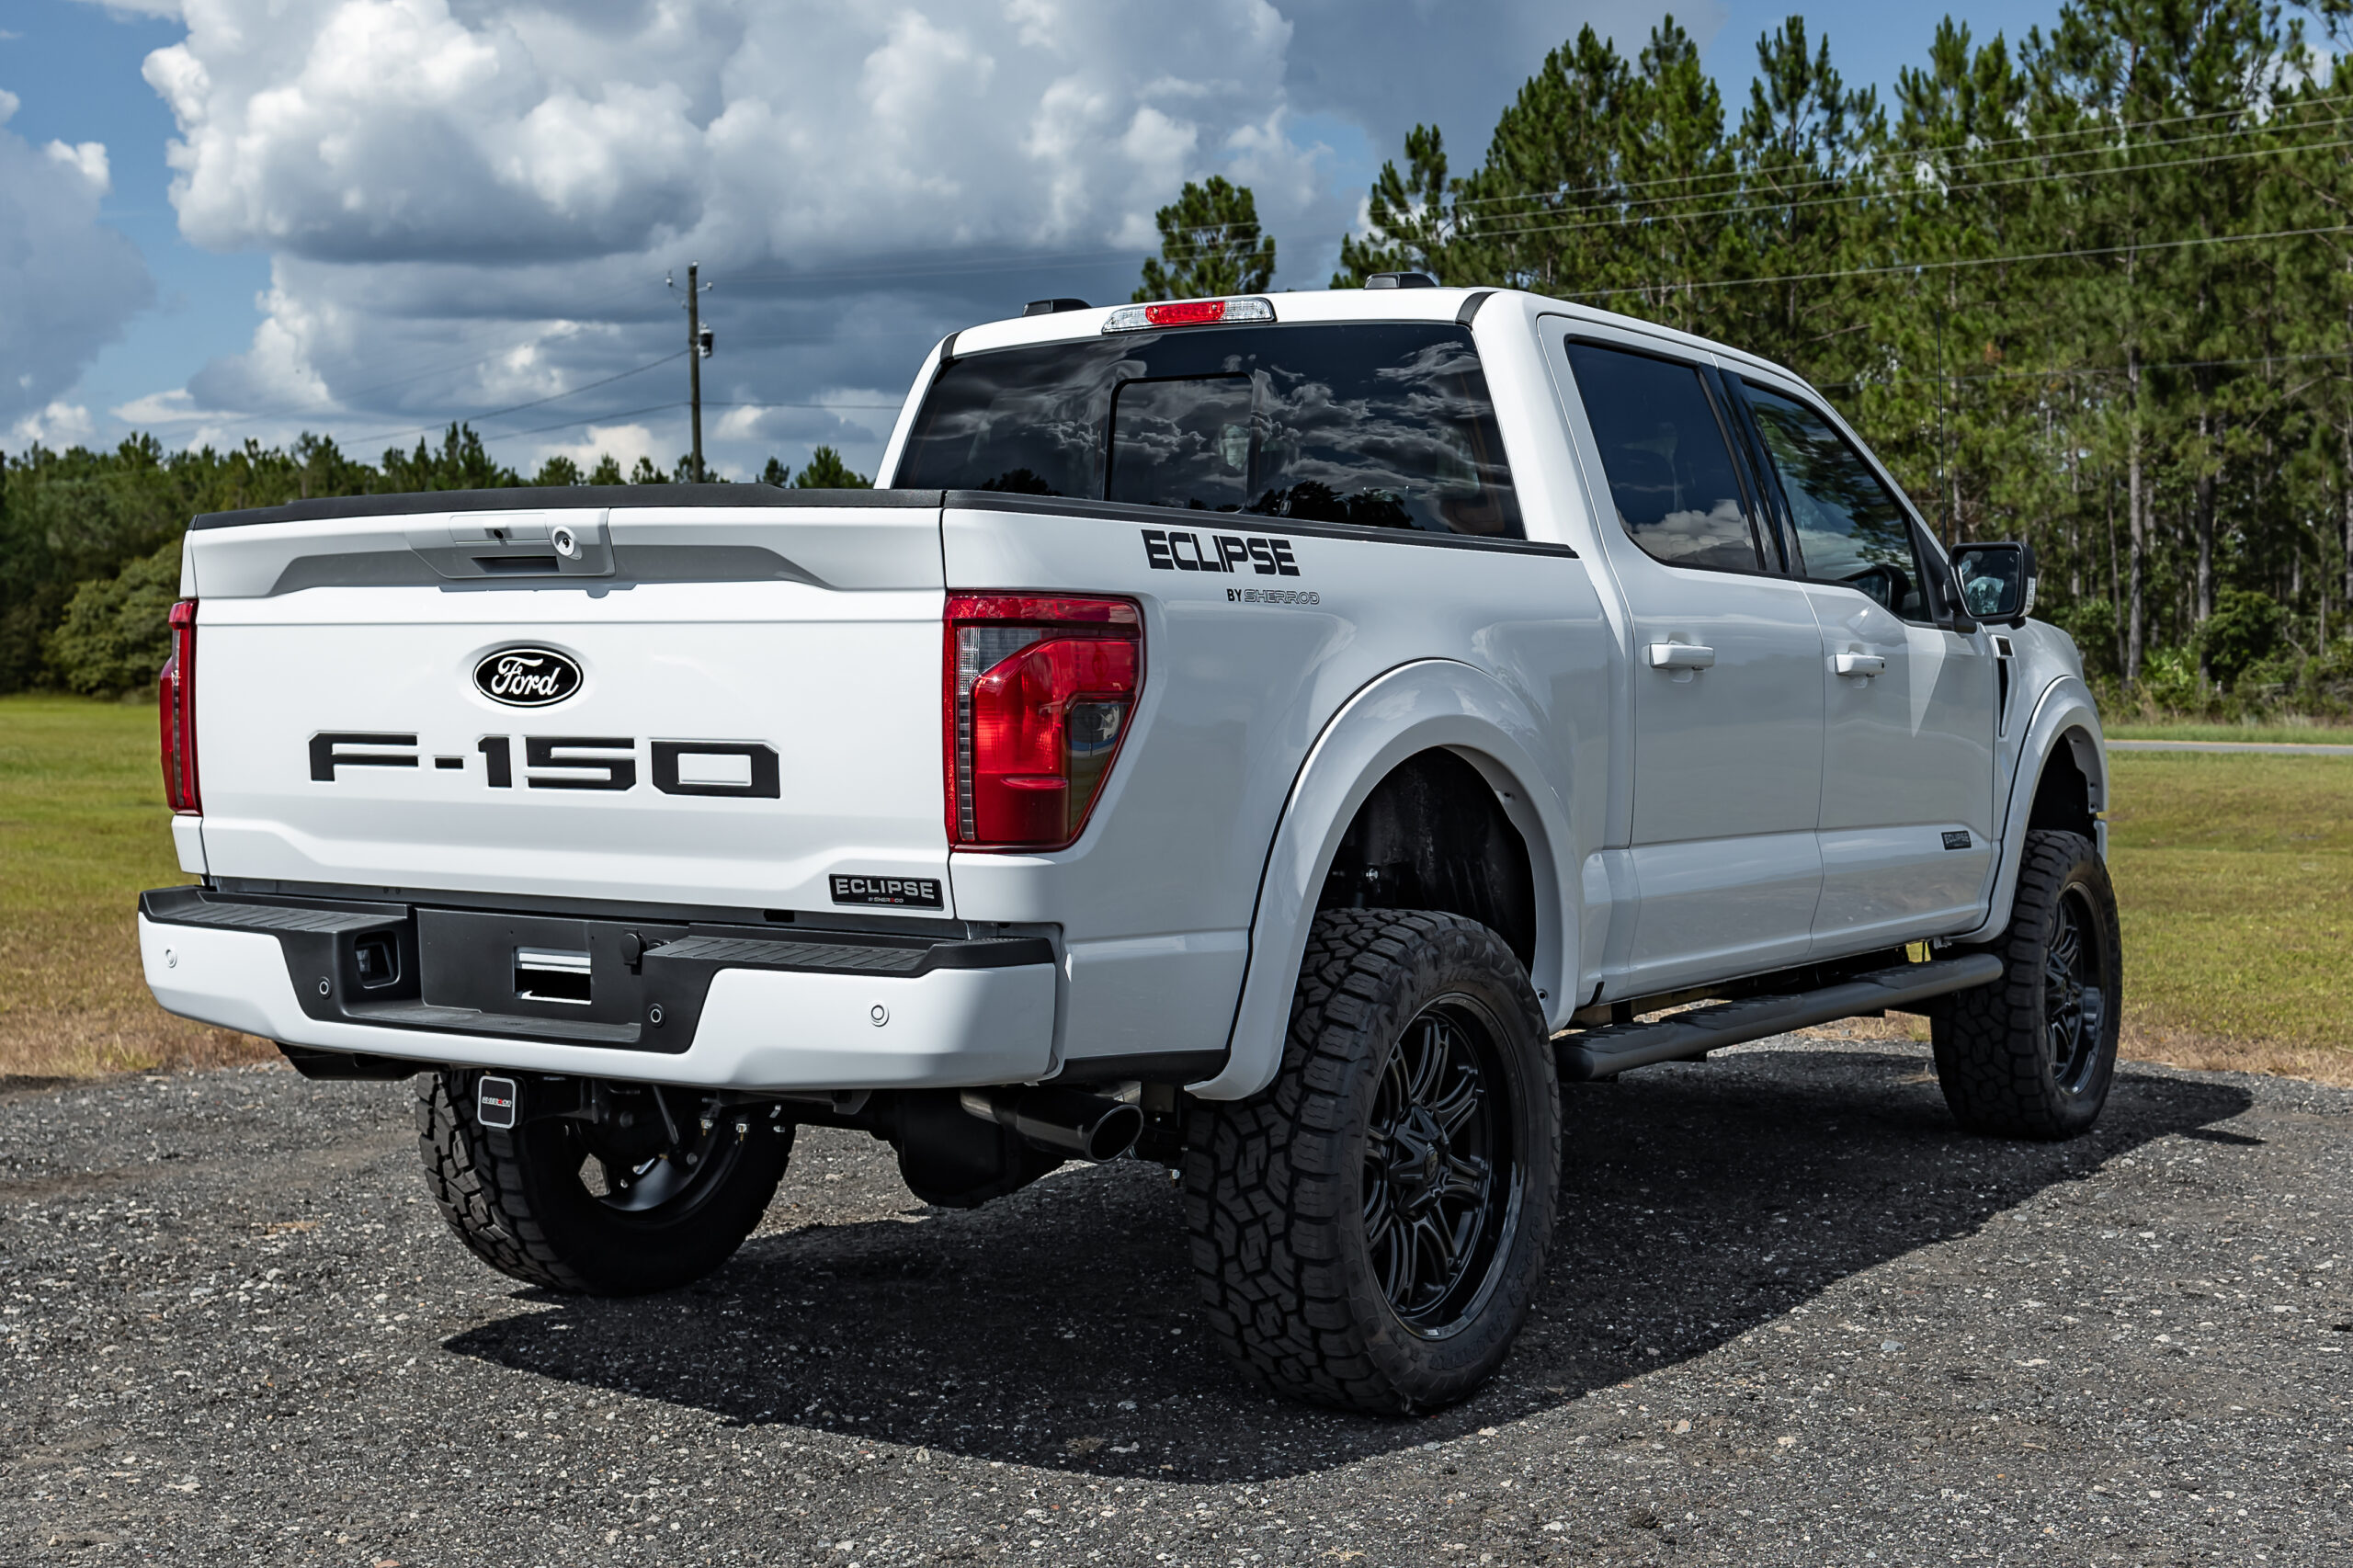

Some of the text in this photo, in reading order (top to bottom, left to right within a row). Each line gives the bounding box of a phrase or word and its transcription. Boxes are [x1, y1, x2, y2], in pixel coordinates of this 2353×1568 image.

[1141, 529, 1301, 576] ECLIPSE
[1226, 588, 1320, 605] BY SHERROD
[491, 656, 561, 695] Ford
[309, 732, 780, 800] F-150
[835, 878, 935, 900] ECLIPSE
